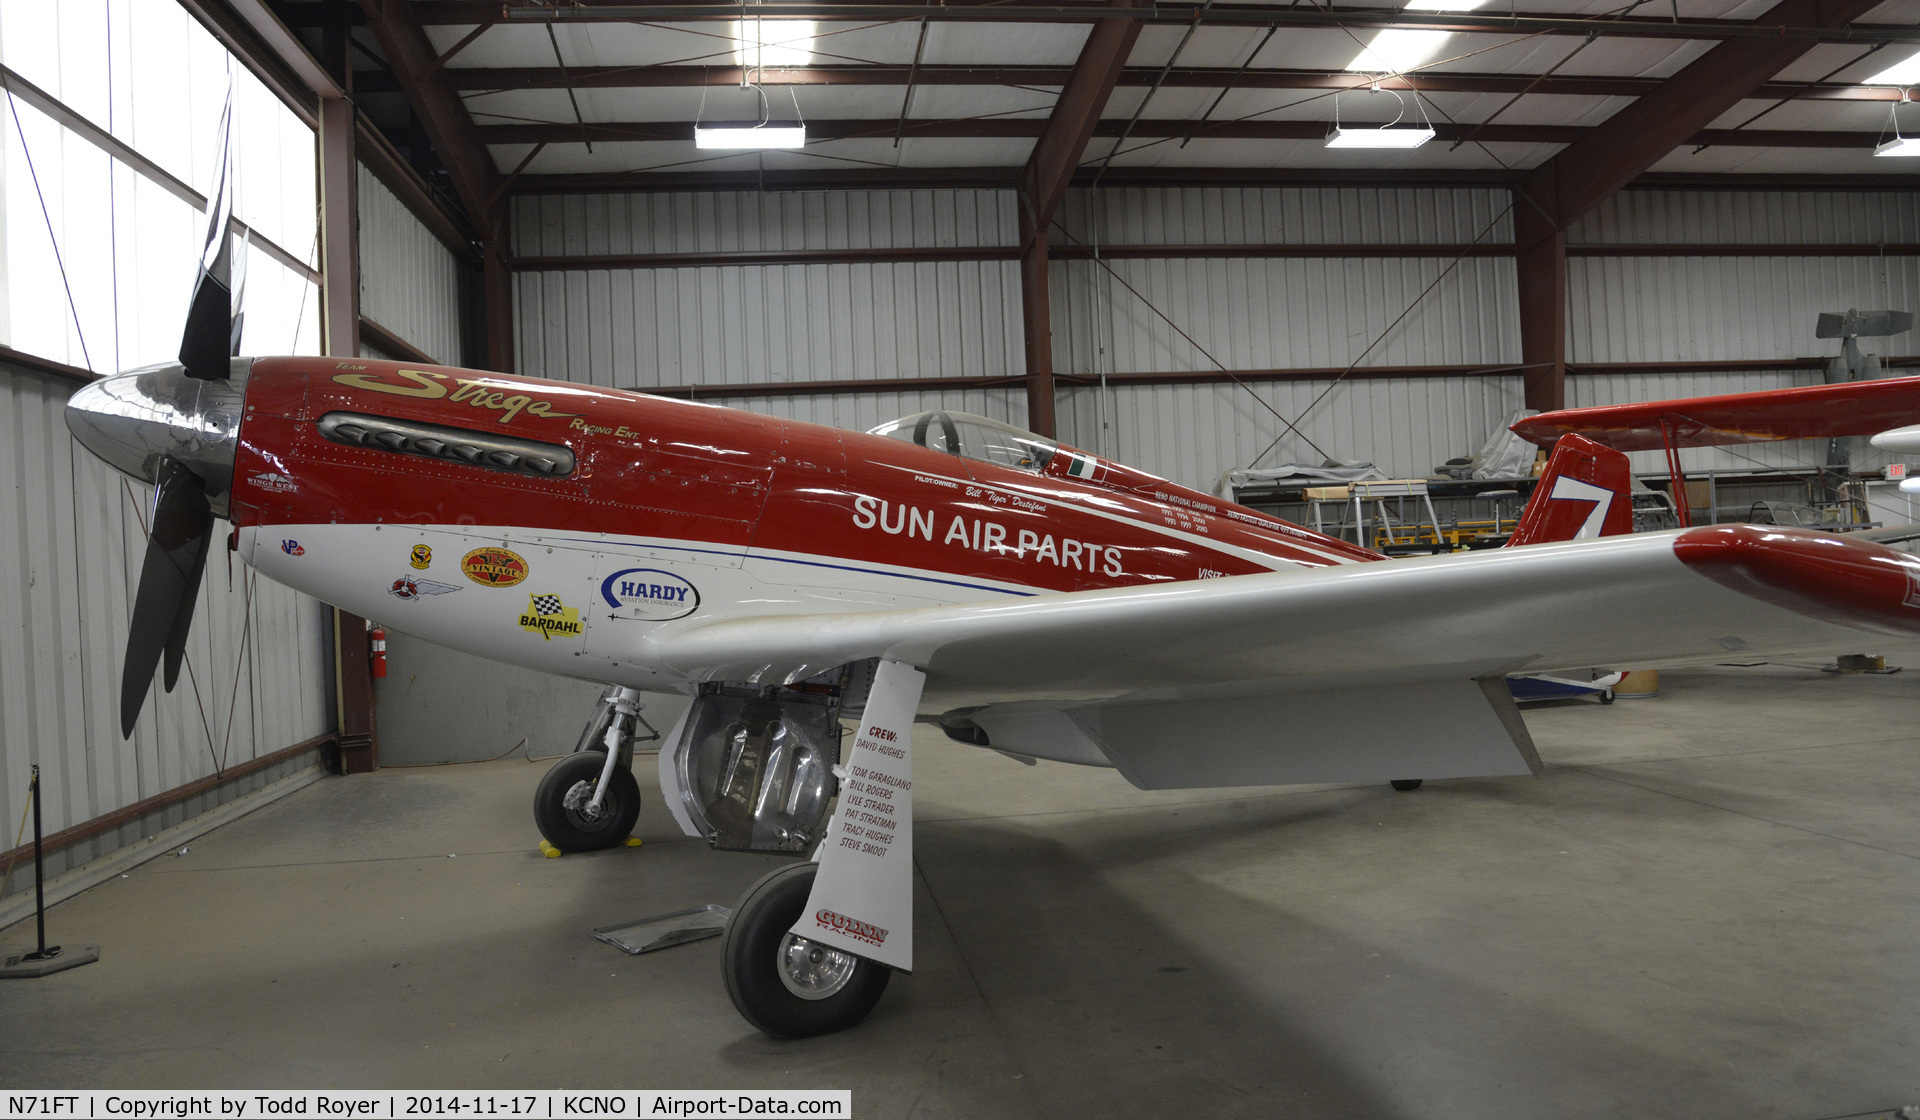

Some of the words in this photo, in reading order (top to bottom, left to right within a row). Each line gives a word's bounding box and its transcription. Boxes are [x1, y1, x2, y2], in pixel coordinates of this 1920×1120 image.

[335, 362, 368, 371] TEAM
[331, 369, 587, 423] Strega
[569, 418, 613, 436] RACING
[1890, 464, 1904, 476] EXIT
[247, 477, 274, 487] WINGS
[275, 482, 299, 491] WEST
[915, 475, 959, 490] PILOT/OWNER:
[965, 486, 982, 498] Bill
[984, 490, 1012, 505] "Tiger"
[1012, 497, 1047, 513] Destefani
[1155, 491, 1169, 502] RENO
[1169, 494, 1192, 508] NATIONAL
[1192, 500, 1217, 514] CHAMPION
[1550, 474, 1616, 541] 7
[282, 539, 298, 555] VP
[852, 496, 934, 542] SUN
[944, 515, 1007, 556] AIR
[1018, 529, 1123, 578] PARTS
[472, 564, 517, 577] VINTAGE
[620, 581, 688, 601] HARDY
[620, 596, 649, 605] AVIATION
[650, 599, 685, 608] INSURANCE
[520, 615, 580, 634] BARDAHL
[869, 726, 898, 742] CREW:
[856, 738, 878, 751] DAVID
[878, 744, 906, 759] HUGHES
[851, 766, 868, 778] TOM
[868, 770, 912, 791] GARAGLIANO
[849, 780, 864, 792] BILL
[865, 784, 894, 800] ROGERS
[847, 794, 863, 807] LYLE
[864, 799, 895, 815] STRADER
[845, 808, 860, 820] PAT
[860, 812, 897, 830] STRATMAN
[842, 823, 866, 836] TRACY
[865, 829, 894, 845] HUGHES
[840, 837, 862, 851] STEVE
[861, 843, 888, 858] SMOOT
[816, 909, 889, 943] GUINN
[816, 922, 882, 947] RACING
